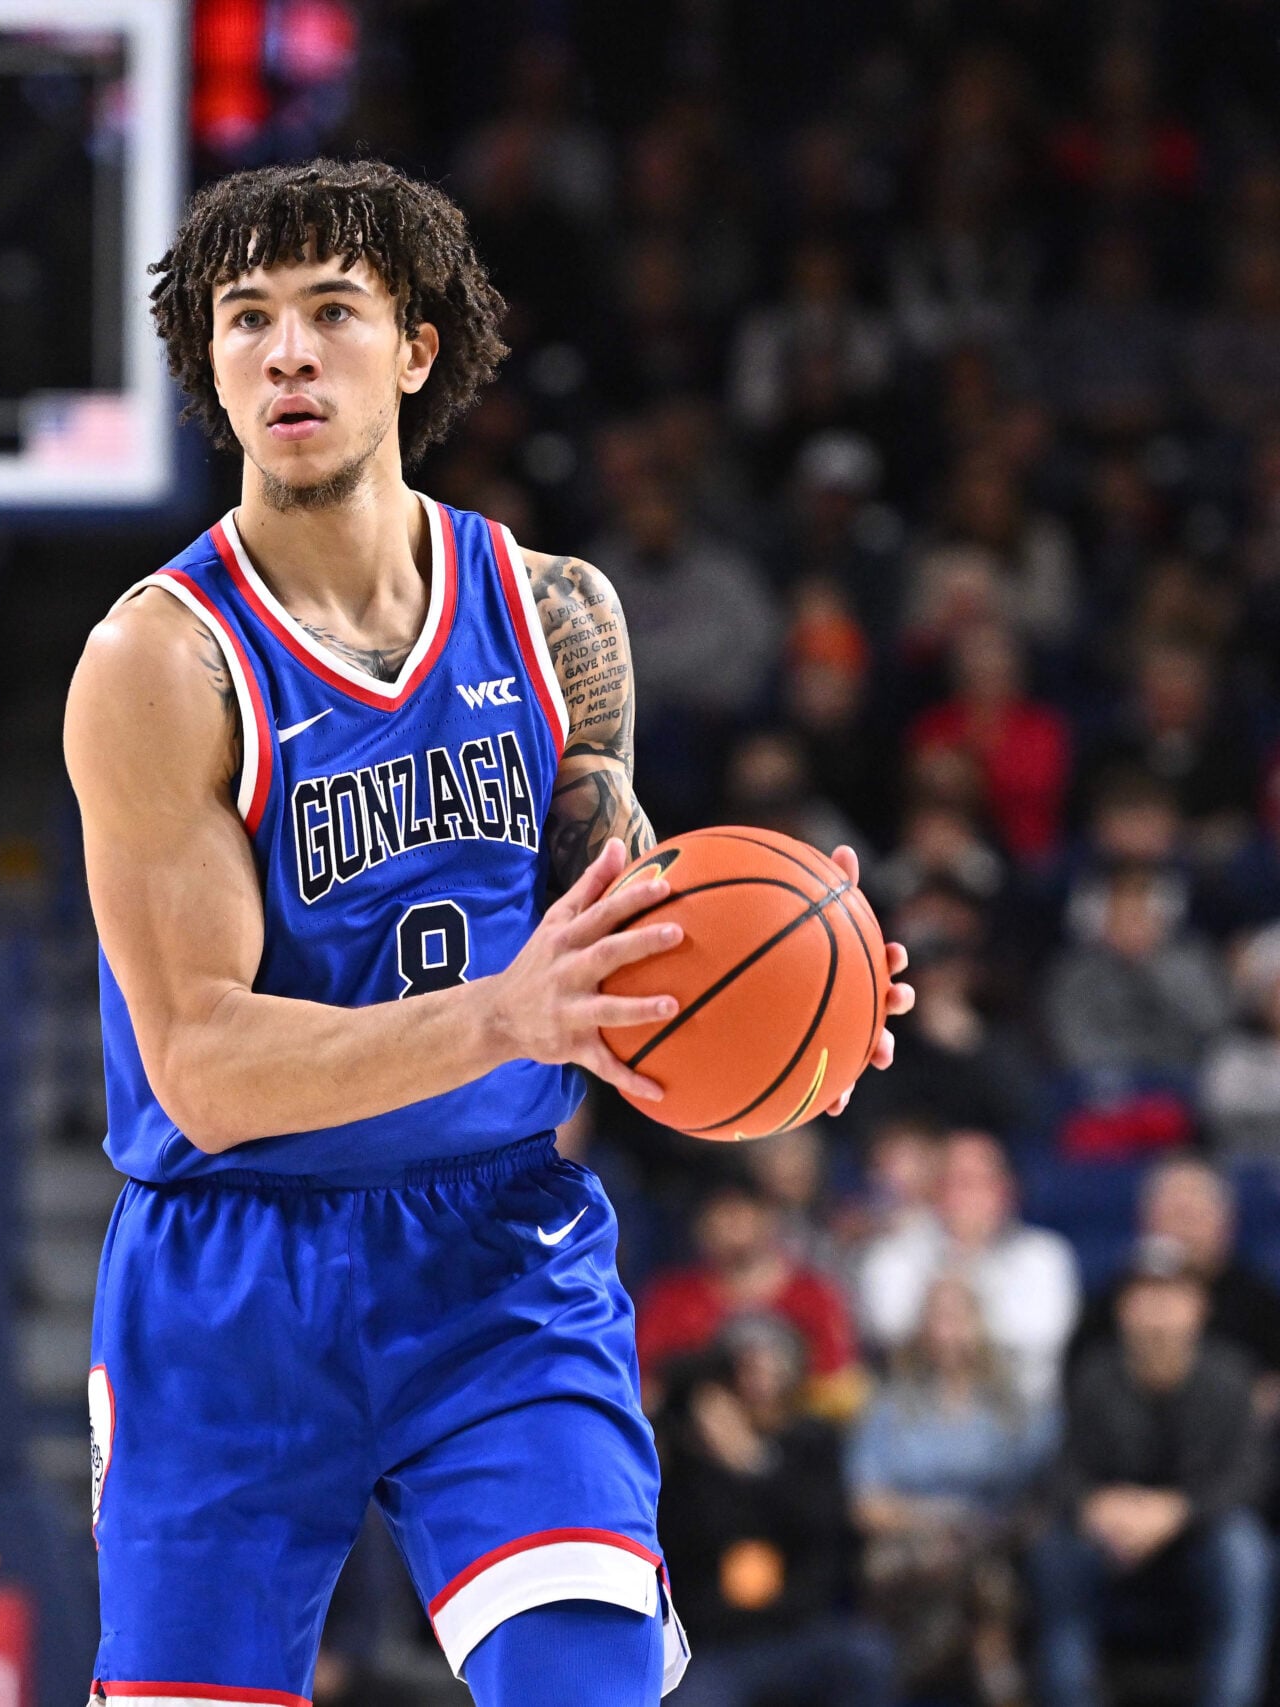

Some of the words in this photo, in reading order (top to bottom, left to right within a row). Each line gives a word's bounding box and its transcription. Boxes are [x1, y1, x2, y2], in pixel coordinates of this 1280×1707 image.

[557, 593, 605, 617] PRAYED
[552, 620, 618, 652] STRENGTH
[571, 613, 595, 629] FOR
[561, 646, 589, 666] AND
[591, 636, 617, 653] GOD
[565, 657, 599, 679] GAVE
[601, 651, 619, 665] ME
[455, 676, 522, 711] WCC
[568, 694, 586, 709] TO
[589, 679, 622, 700] MAKE
[587, 698, 608, 714] ME
[569, 708, 621, 735] STRONG
[291, 730, 540, 906] GONZAGA
[396, 899, 470, 1001] 8
